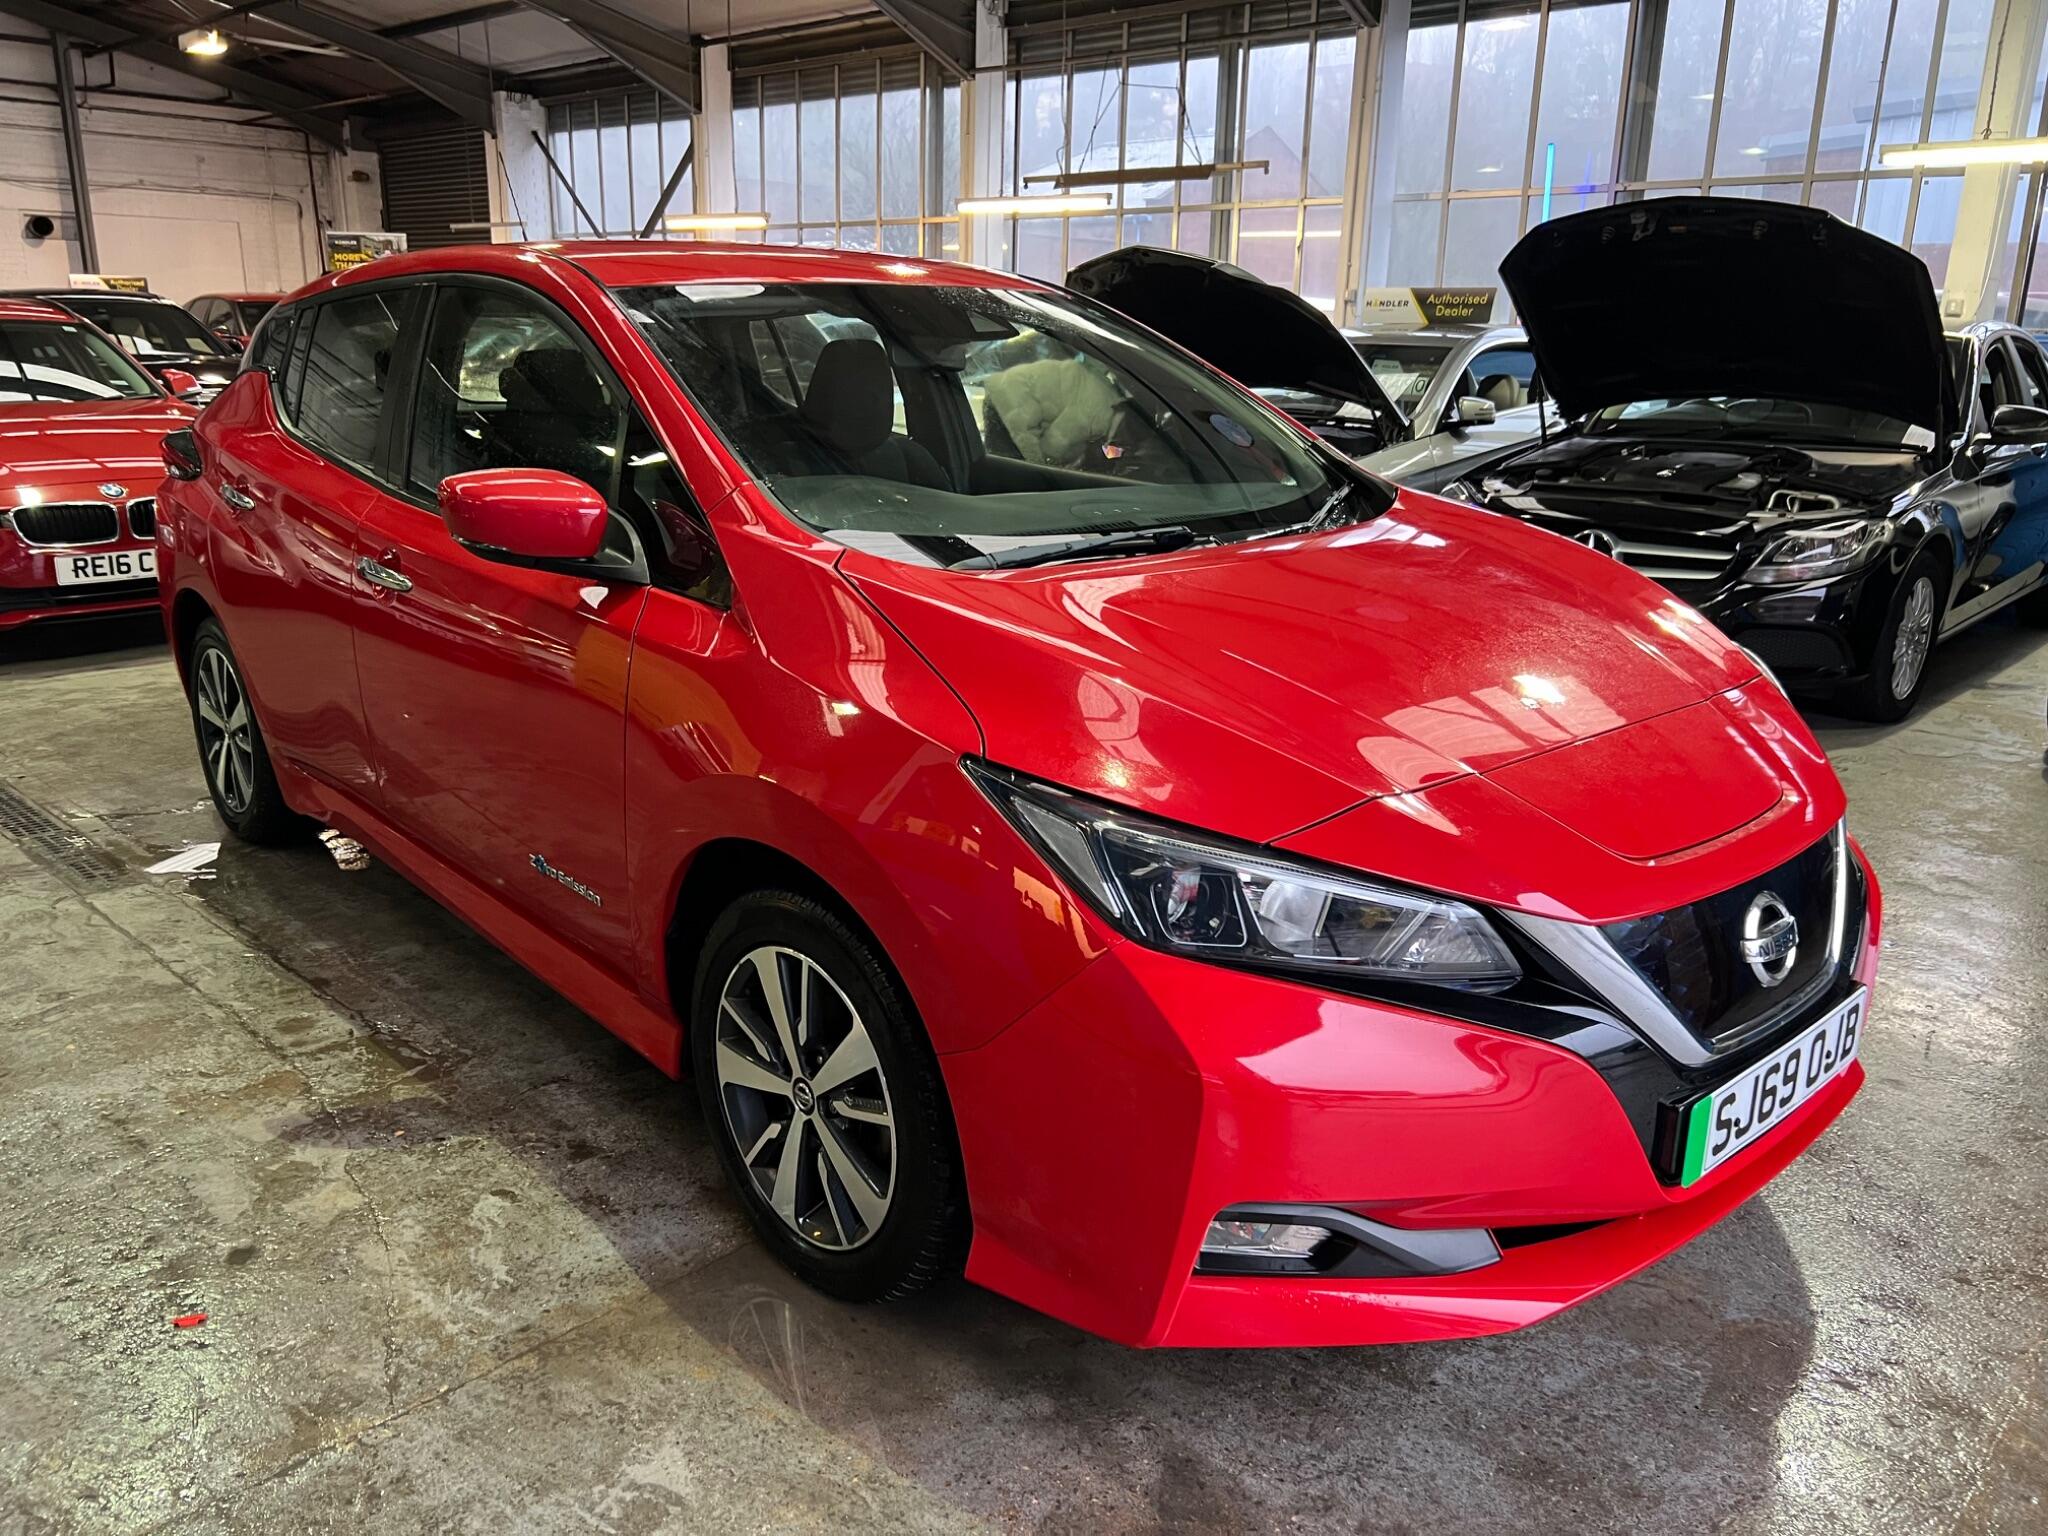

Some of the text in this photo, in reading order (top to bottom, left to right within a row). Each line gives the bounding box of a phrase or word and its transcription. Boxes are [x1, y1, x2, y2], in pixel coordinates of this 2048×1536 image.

[1427, 294, 1488, 305] Authorised
[1436, 306, 1474, 317] Dealer
[73, 554, 131, 579] RE16
[1712, 1003, 1860, 1157] SJ69 OJB
